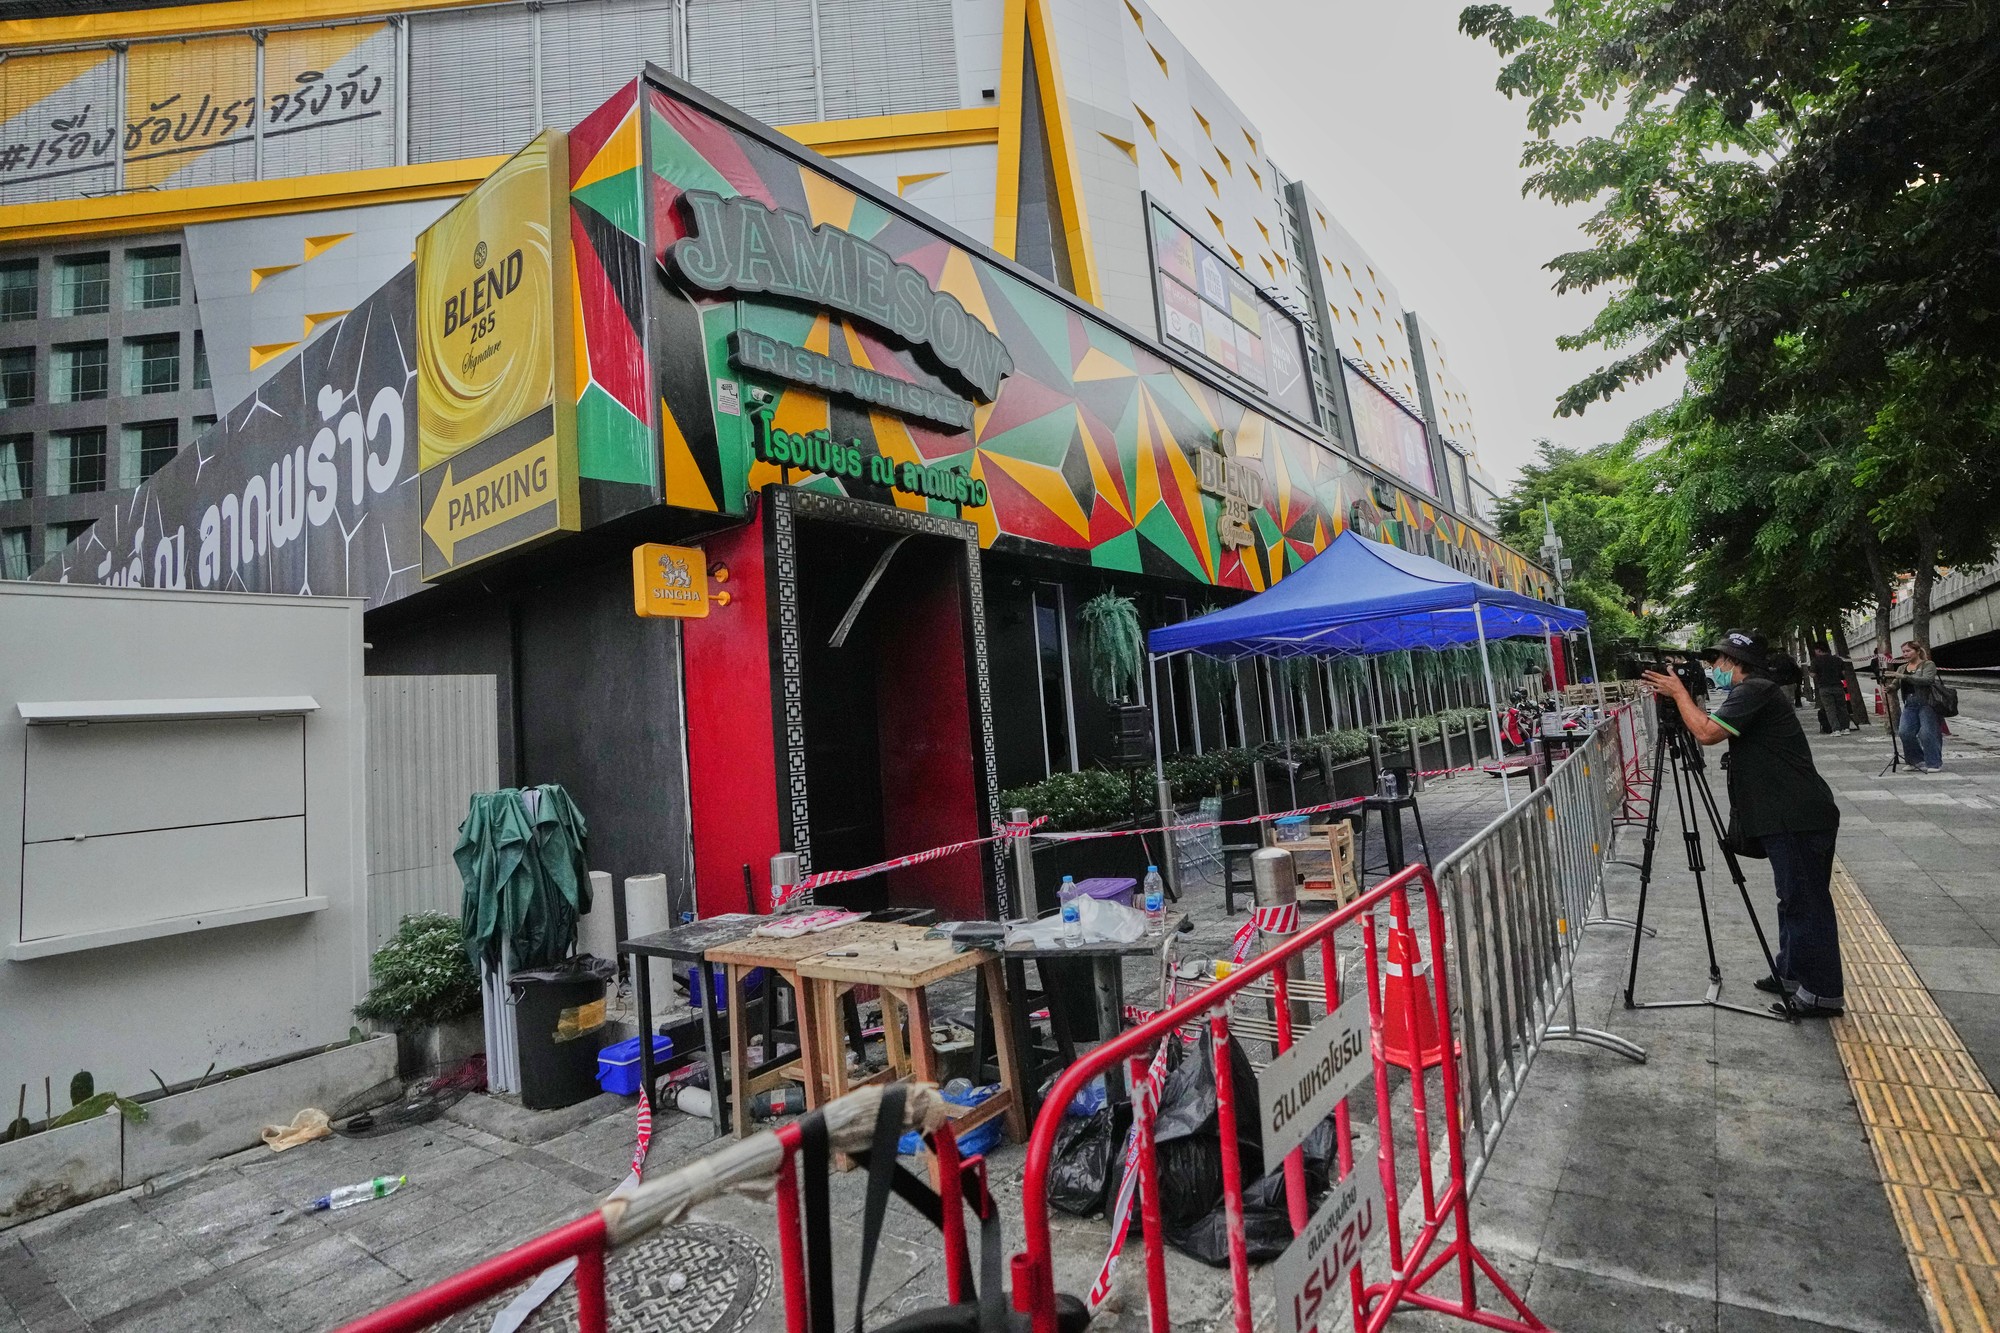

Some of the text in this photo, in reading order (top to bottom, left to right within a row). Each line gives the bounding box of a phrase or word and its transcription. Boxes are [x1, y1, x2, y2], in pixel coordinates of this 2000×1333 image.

[444, 248, 523, 338] BLEND
[470, 310, 496, 344] 285
[674, 197, 1004, 395] JAMESON
[462, 340, 502, 379] Signature
[742, 334, 972, 426] IRISH WHISKEY
[199, 384, 405, 588] ลาดพร้าว
[448, 456, 548, 531] PARKING
[760, 409, 987, 506] โรงเบียร์ ณ ลาดพร้าว
[1203, 453, 1262, 505] BLEND
[1226, 500, 1248, 520] 285
[653, 588, 701, 602] SINGHA
[1294, 1197, 1373, 1333] ISUZU
